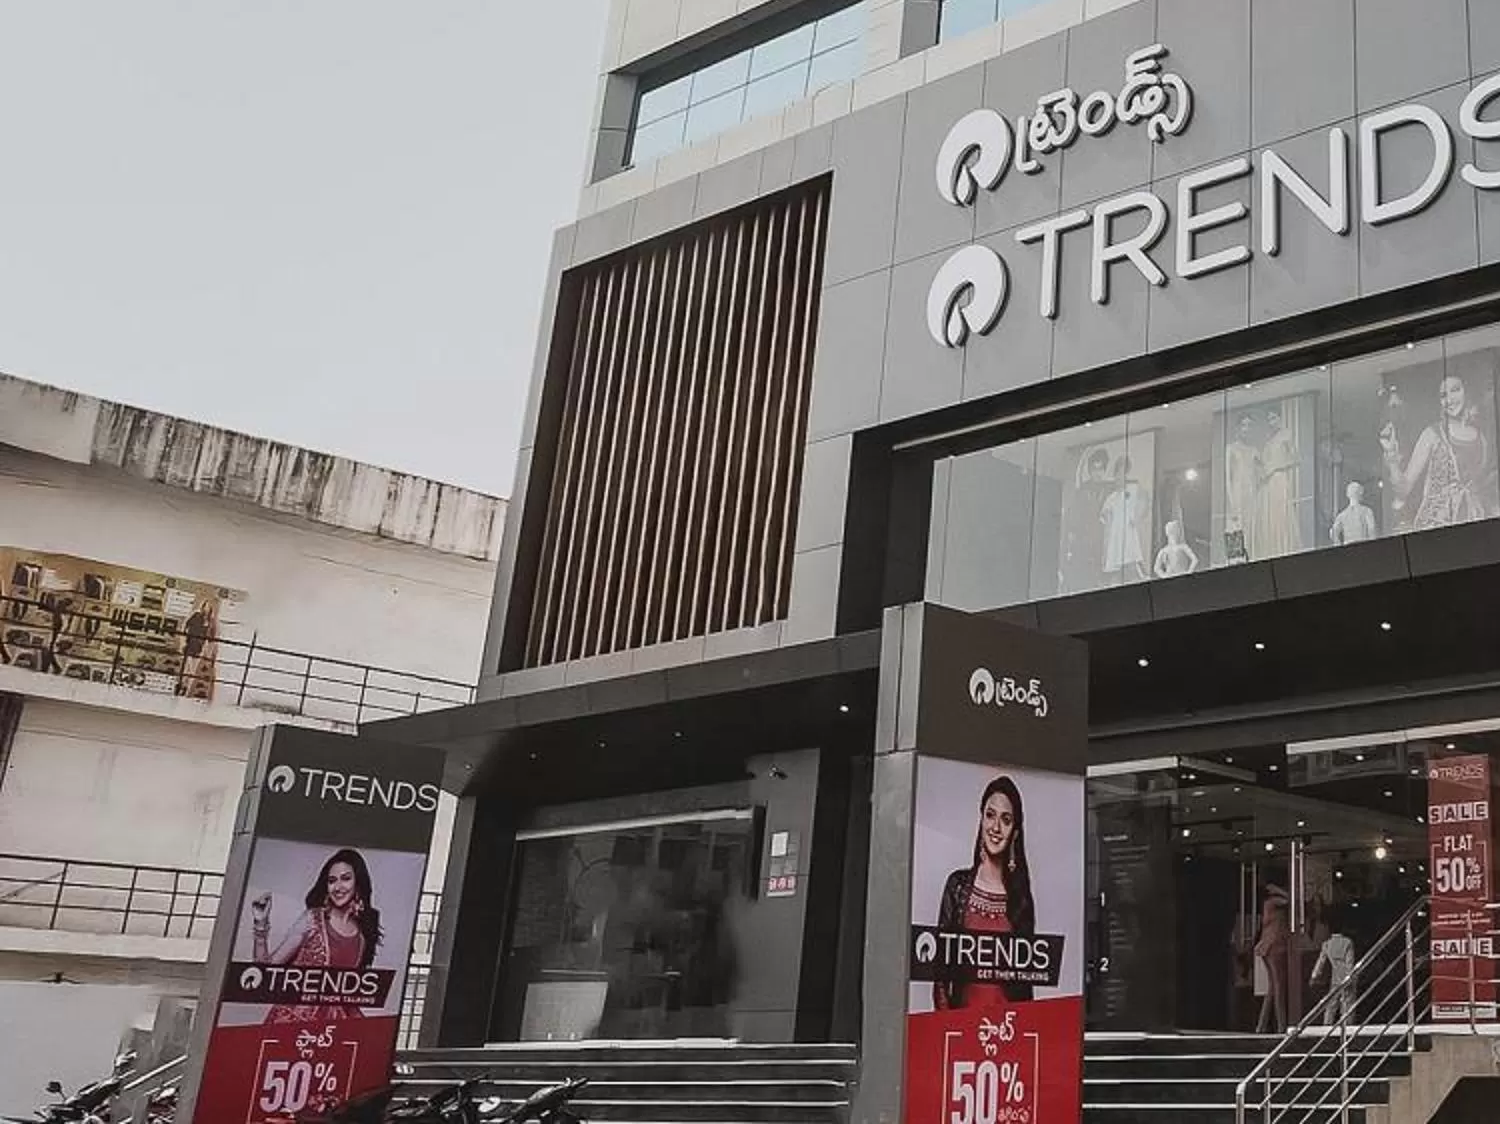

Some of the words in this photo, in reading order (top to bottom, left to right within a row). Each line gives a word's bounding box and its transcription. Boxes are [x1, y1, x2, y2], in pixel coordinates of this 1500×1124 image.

[1438, 763, 1485, 780] TRENDS
[300, 767, 440, 812] TRENDS
[1429, 802, 1488, 824] SALE
[1443, 834, 1472, 852] FLAT
[1436, 856, 1481, 893] 50%
[1466, 873, 1484, 891] OFF
[939, 932, 1050, 969] TRENDS
[1099, 957, 1109, 972] 2
[265, 967, 379, 995] TRENDS
[977, 969, 993, 980] GET
[259, 1060, 337, 1113] 50%
[951, 1060, 1024, 1124] 50%
